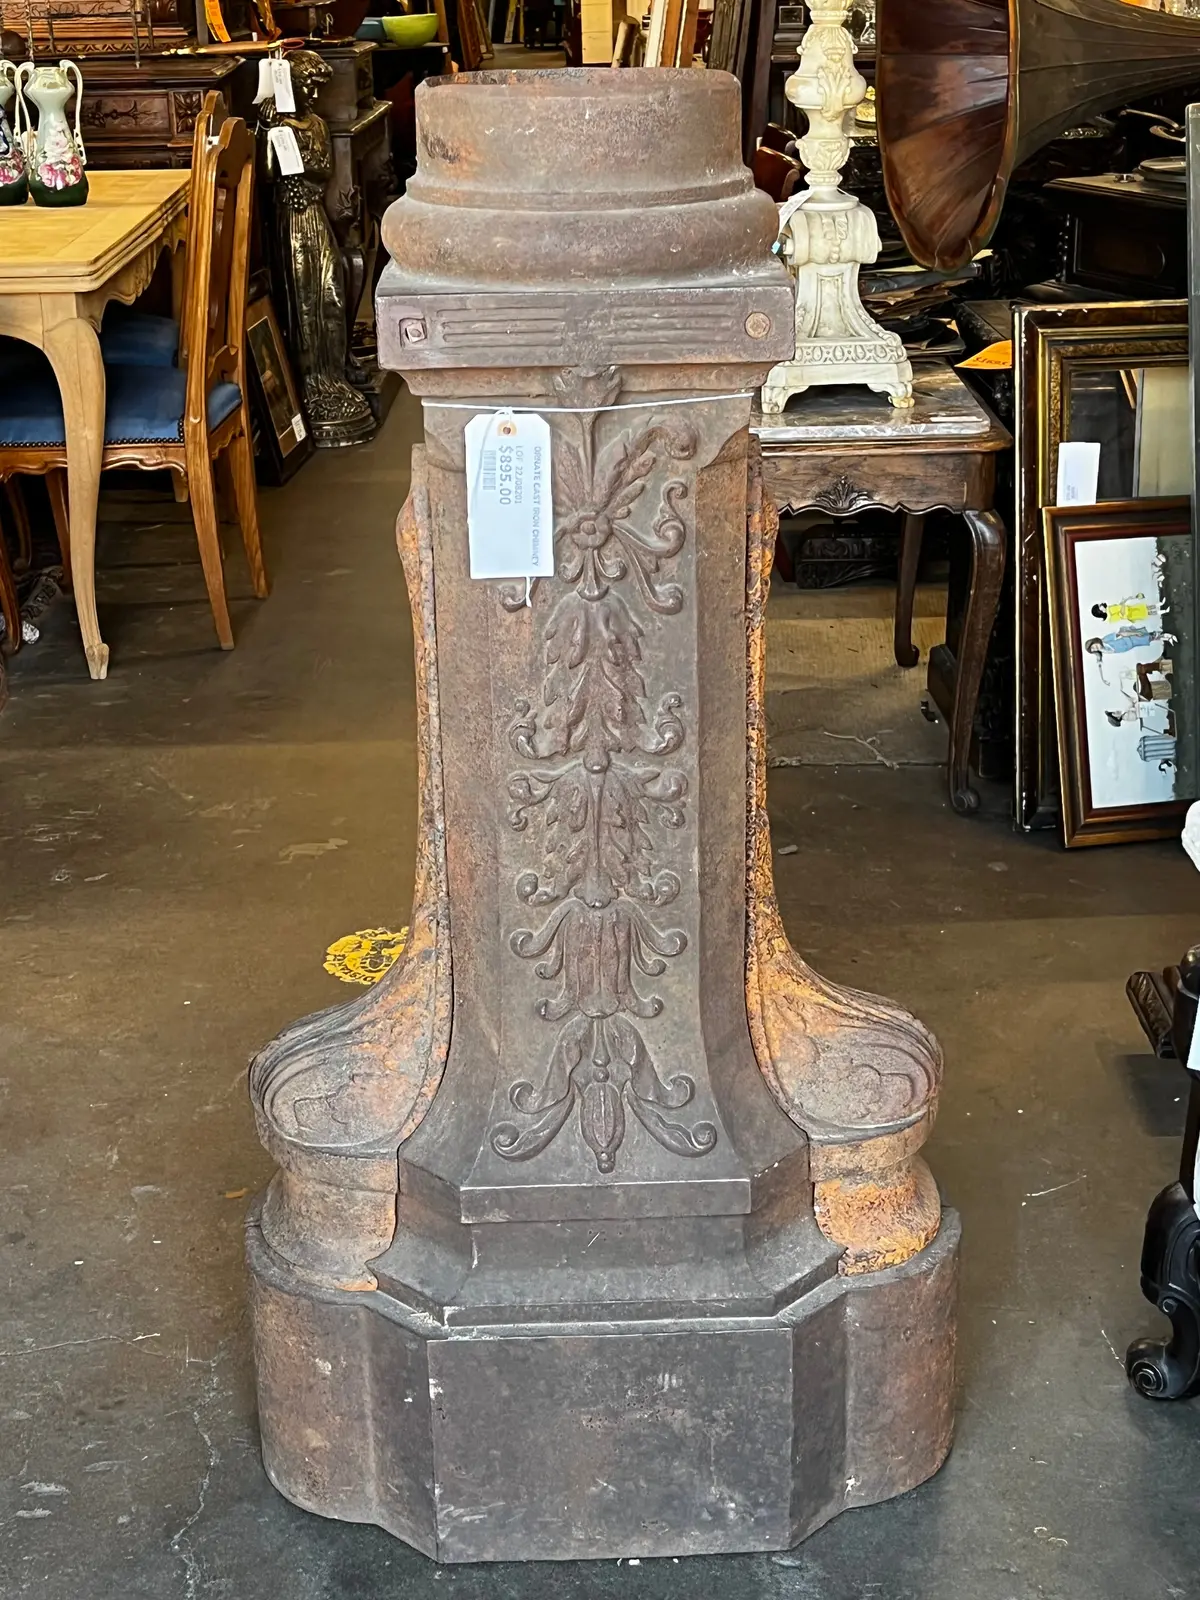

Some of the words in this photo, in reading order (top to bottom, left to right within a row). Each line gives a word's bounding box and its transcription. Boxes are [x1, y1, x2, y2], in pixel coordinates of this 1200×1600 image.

[499, 445, 514, 505] $895.00
[533, 446, 542, 480] ORNATE
[533, 483, 541, 505] CAST
[532, 507, 541, 528] IRON
[532, 529, 540, 566] CHIMNEY
